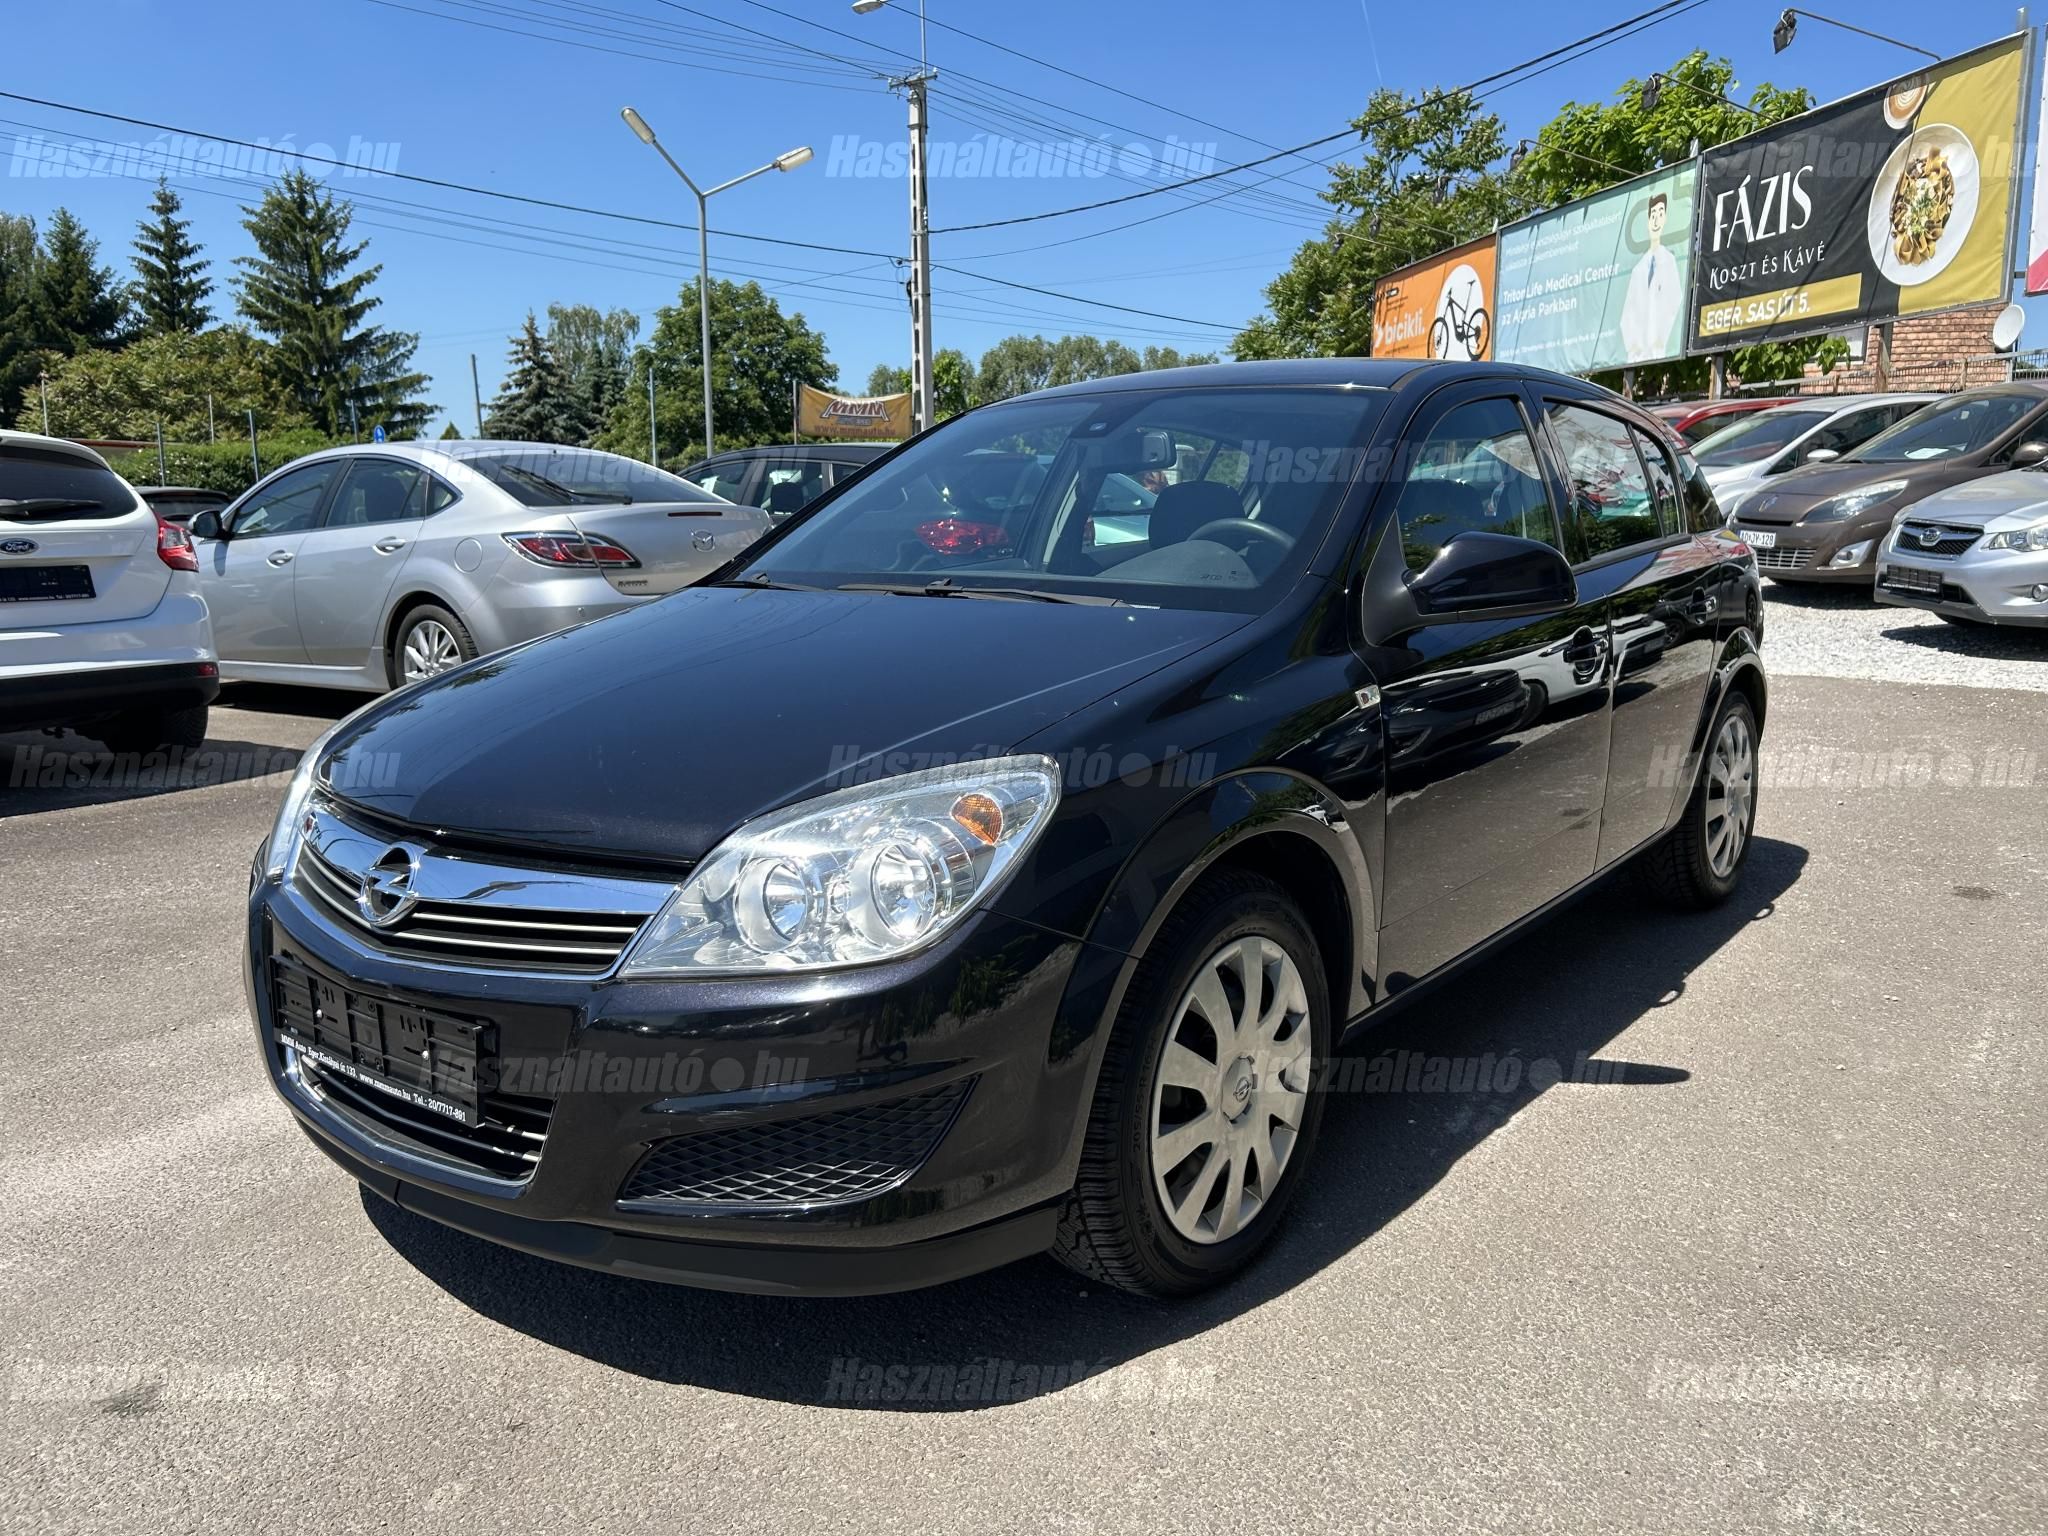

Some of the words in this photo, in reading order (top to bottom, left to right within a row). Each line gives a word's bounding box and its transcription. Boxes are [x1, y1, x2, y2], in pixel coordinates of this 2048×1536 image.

[1713, 165, 1814, 252] FÁZIS
[1545, 269, 1582, 293] Medical
[1585, 263, 1620, 283] Center
[1709, 261, 1757, 291] KOSZT
[1761, 254, 1778, 275] ÉS
[1783, 240, 1825, 274] KÁVÉ
[1538, 297, 1577, 318] Parkban
[1706, 305, 1744, 331] EGER,
[1746, 302, 1773, 323] SAS
[1798, 292, 1810, 313] 5.
